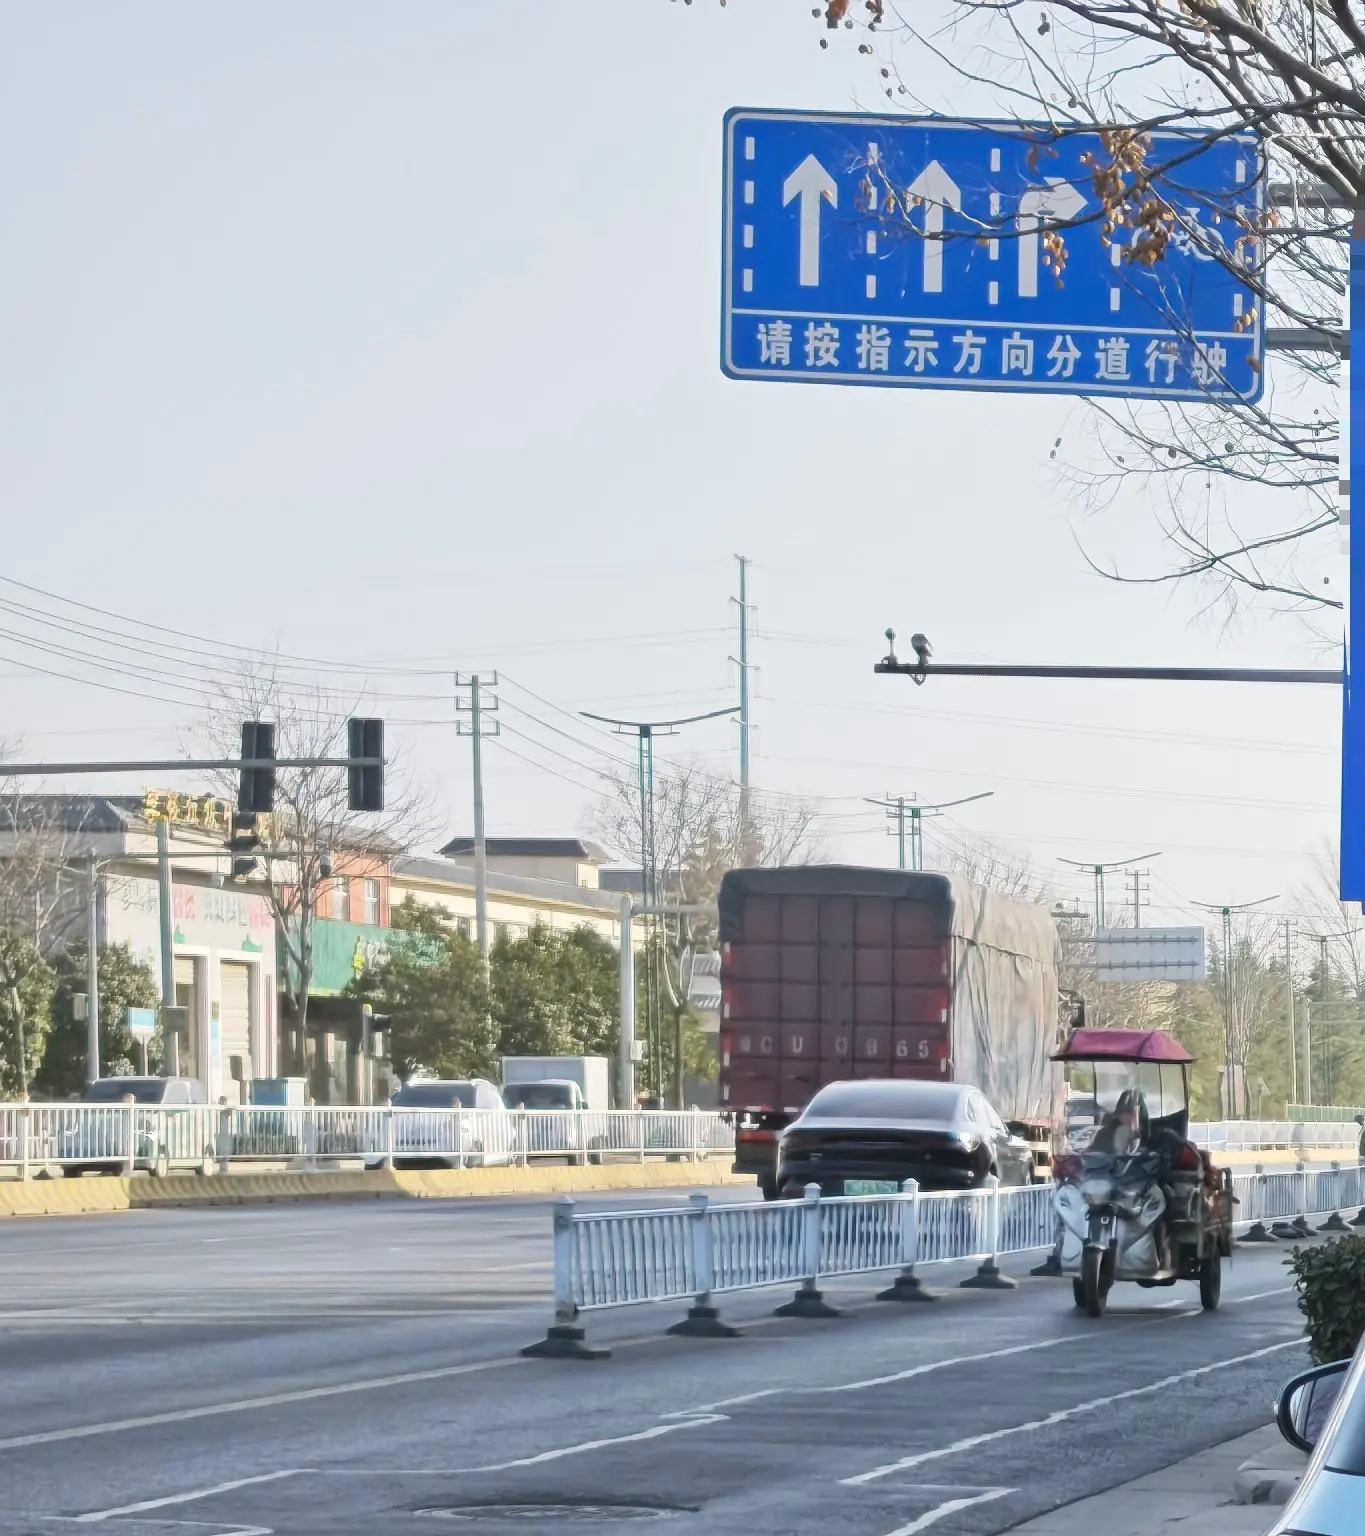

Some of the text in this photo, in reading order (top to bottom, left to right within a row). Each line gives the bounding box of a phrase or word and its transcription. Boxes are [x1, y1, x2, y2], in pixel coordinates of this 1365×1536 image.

[757, 320, 1228, 386] 请按指示方向分道行驶
